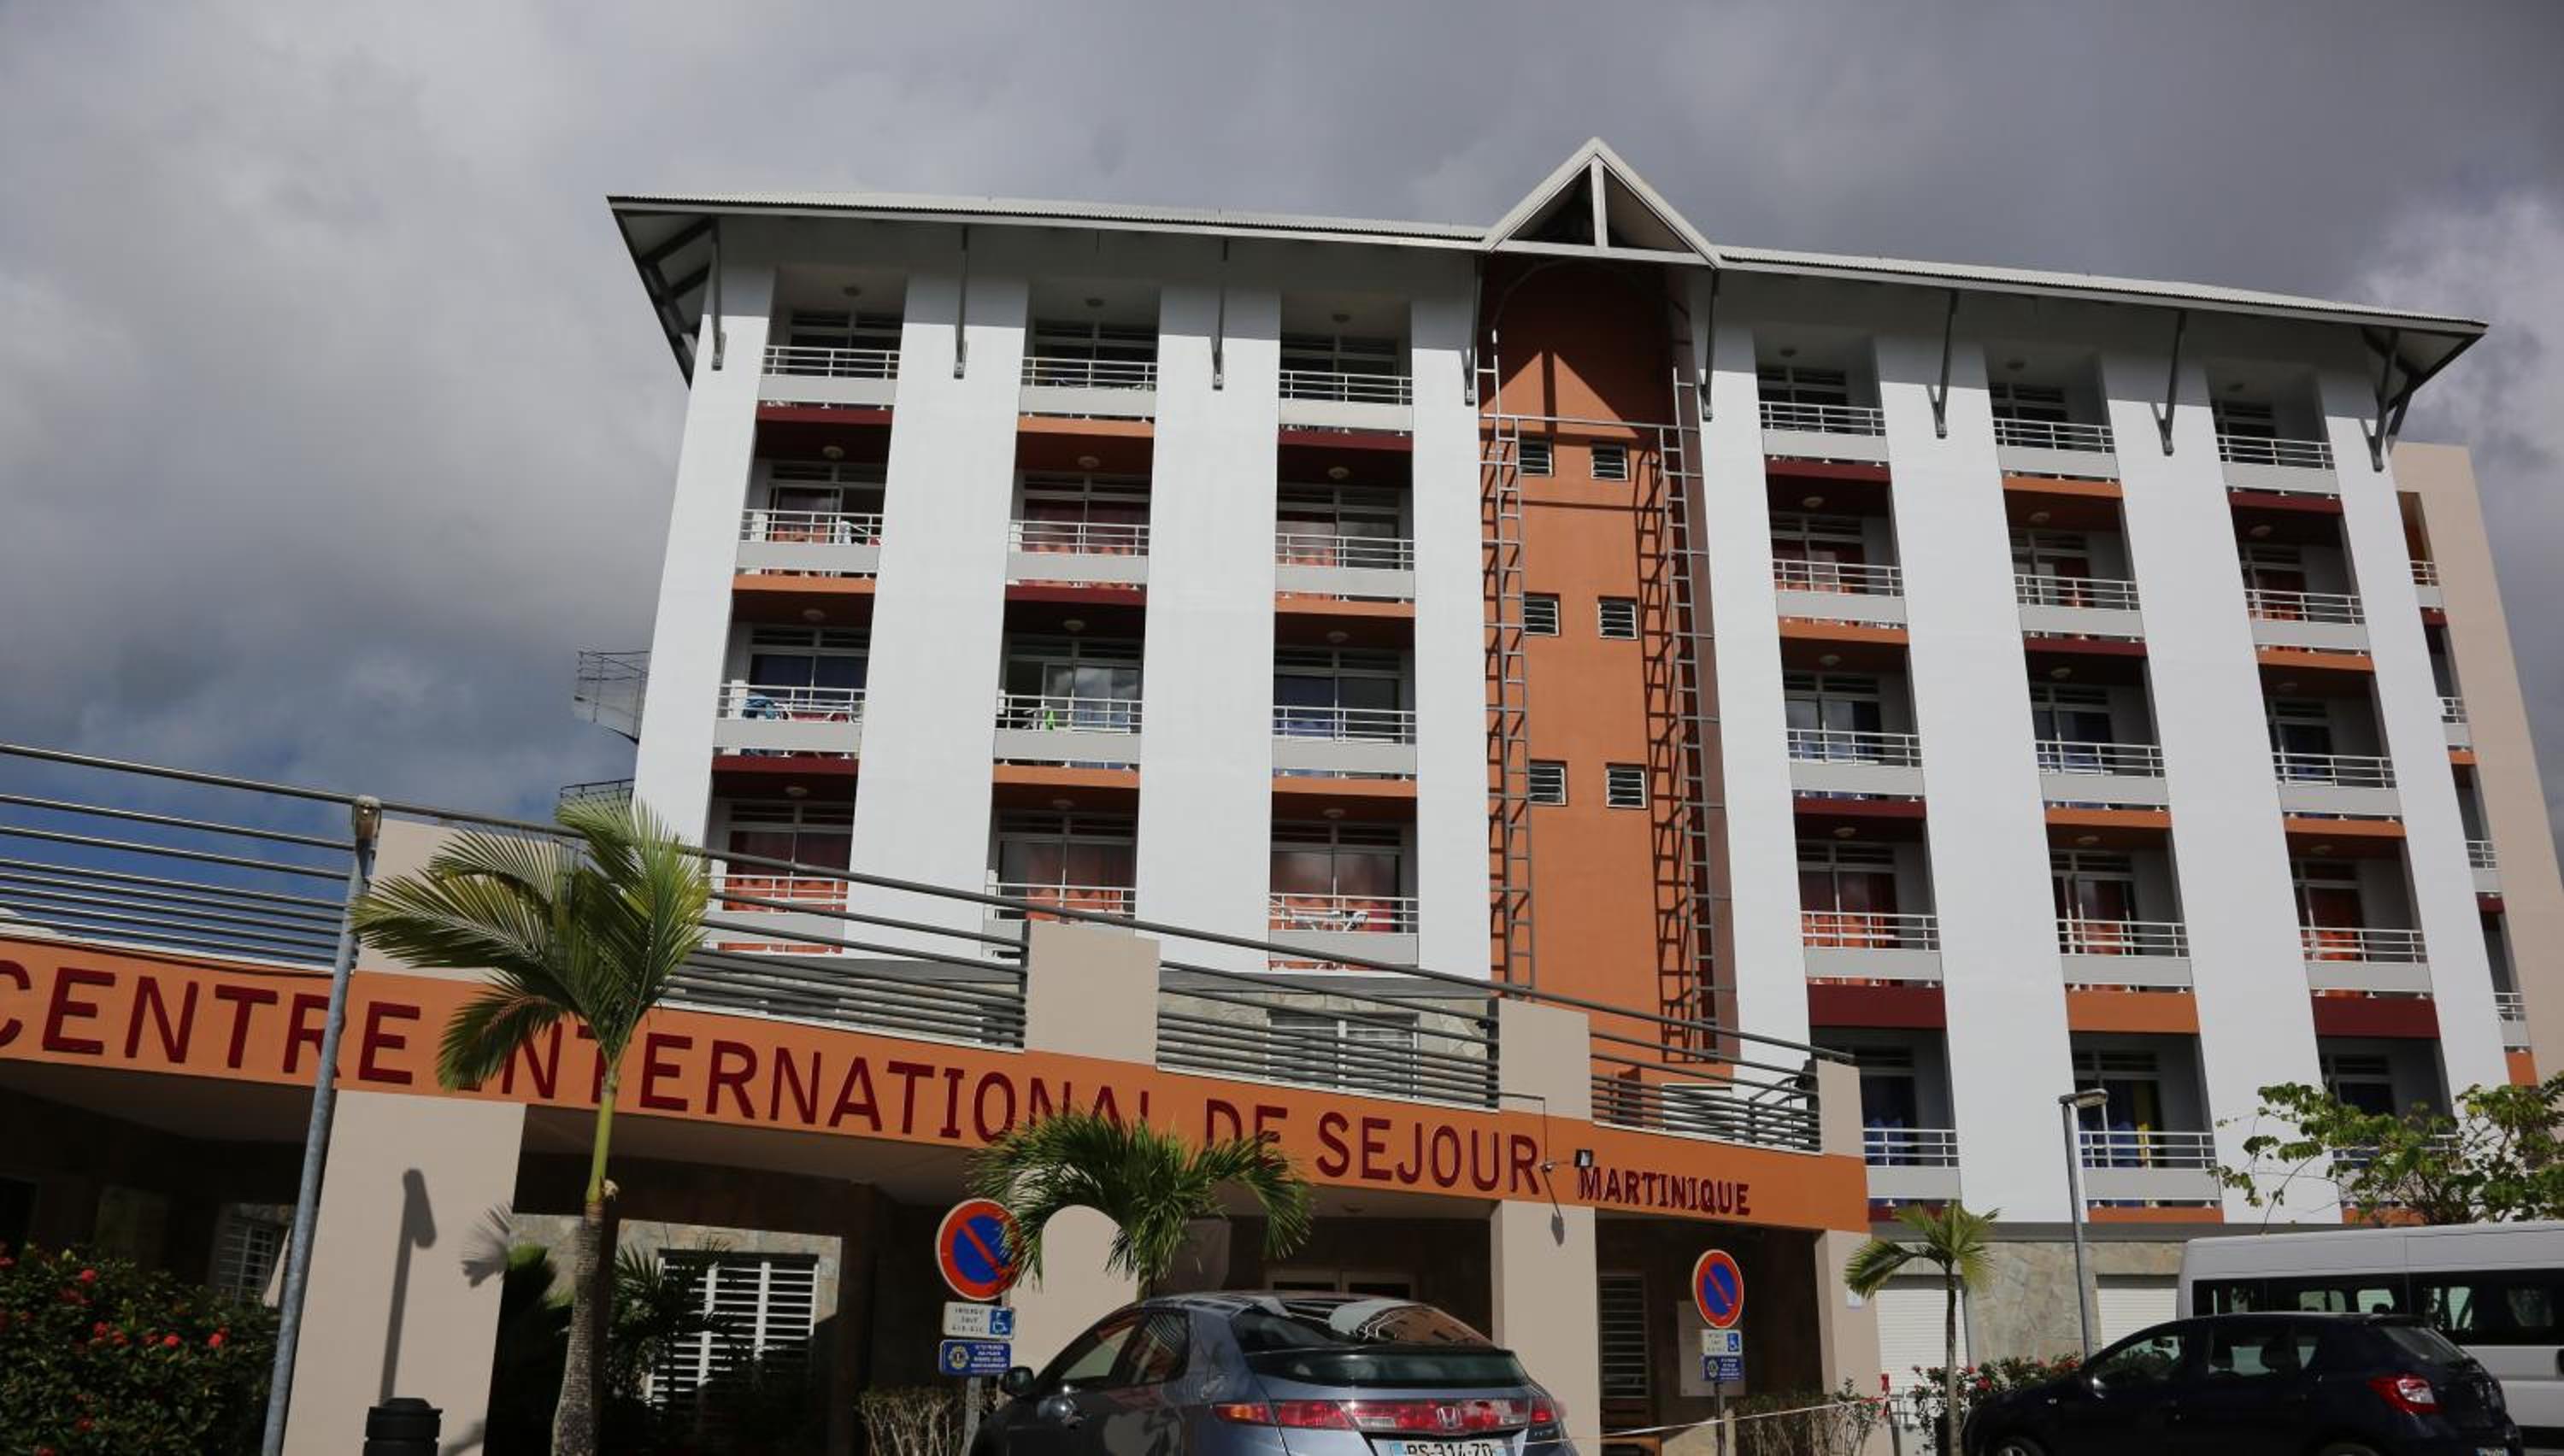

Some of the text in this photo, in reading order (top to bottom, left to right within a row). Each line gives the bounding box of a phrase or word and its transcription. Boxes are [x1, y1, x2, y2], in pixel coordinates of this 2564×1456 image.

[457, 1019, 1150, 1142] NERNATION
[1206, 1097, 1288, 1170] DE
[1316, 1112, 1539, 1195] SEJOUR
[1578, 1165, 1751, 1215] MARTINIQUE
